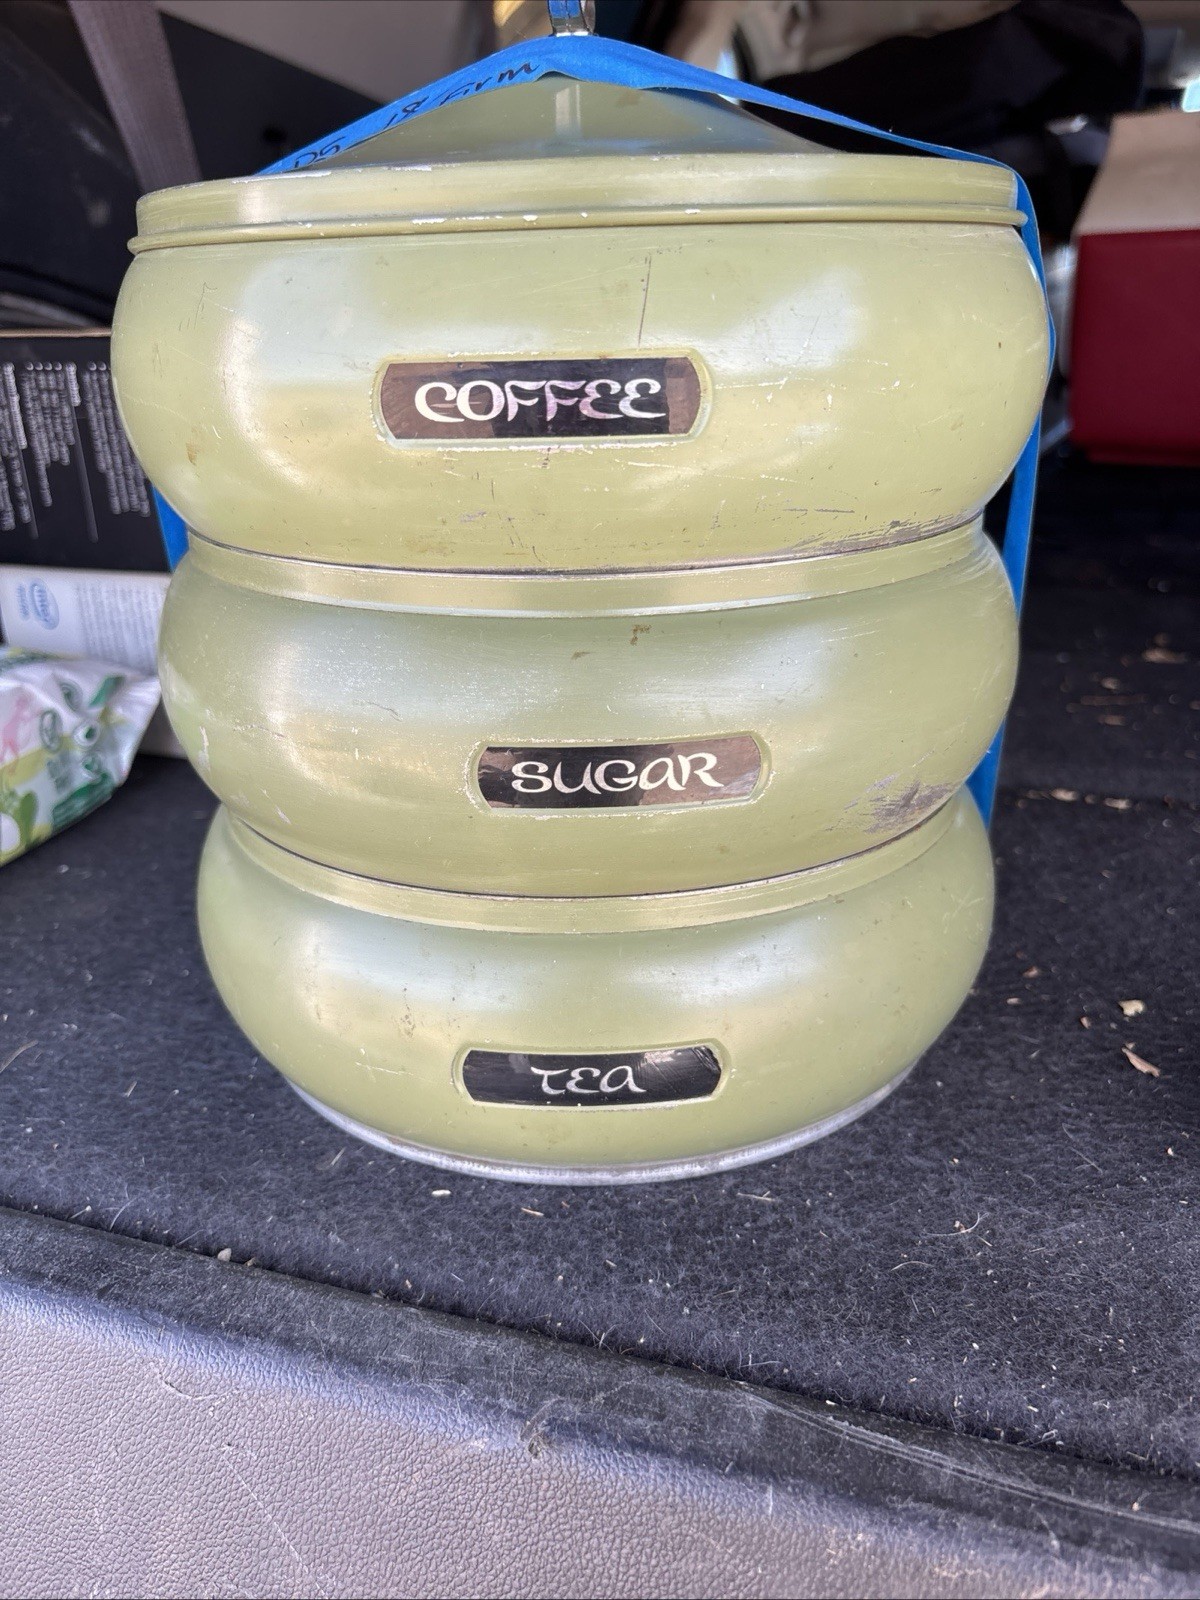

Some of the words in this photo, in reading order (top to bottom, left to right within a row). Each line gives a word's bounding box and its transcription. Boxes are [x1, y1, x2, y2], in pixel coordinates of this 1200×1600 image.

[414, 378, 666, 423] COFFEE
[511, 752, 724, 795] SUGAR
[530, 1065, 647, 1095] TEA
